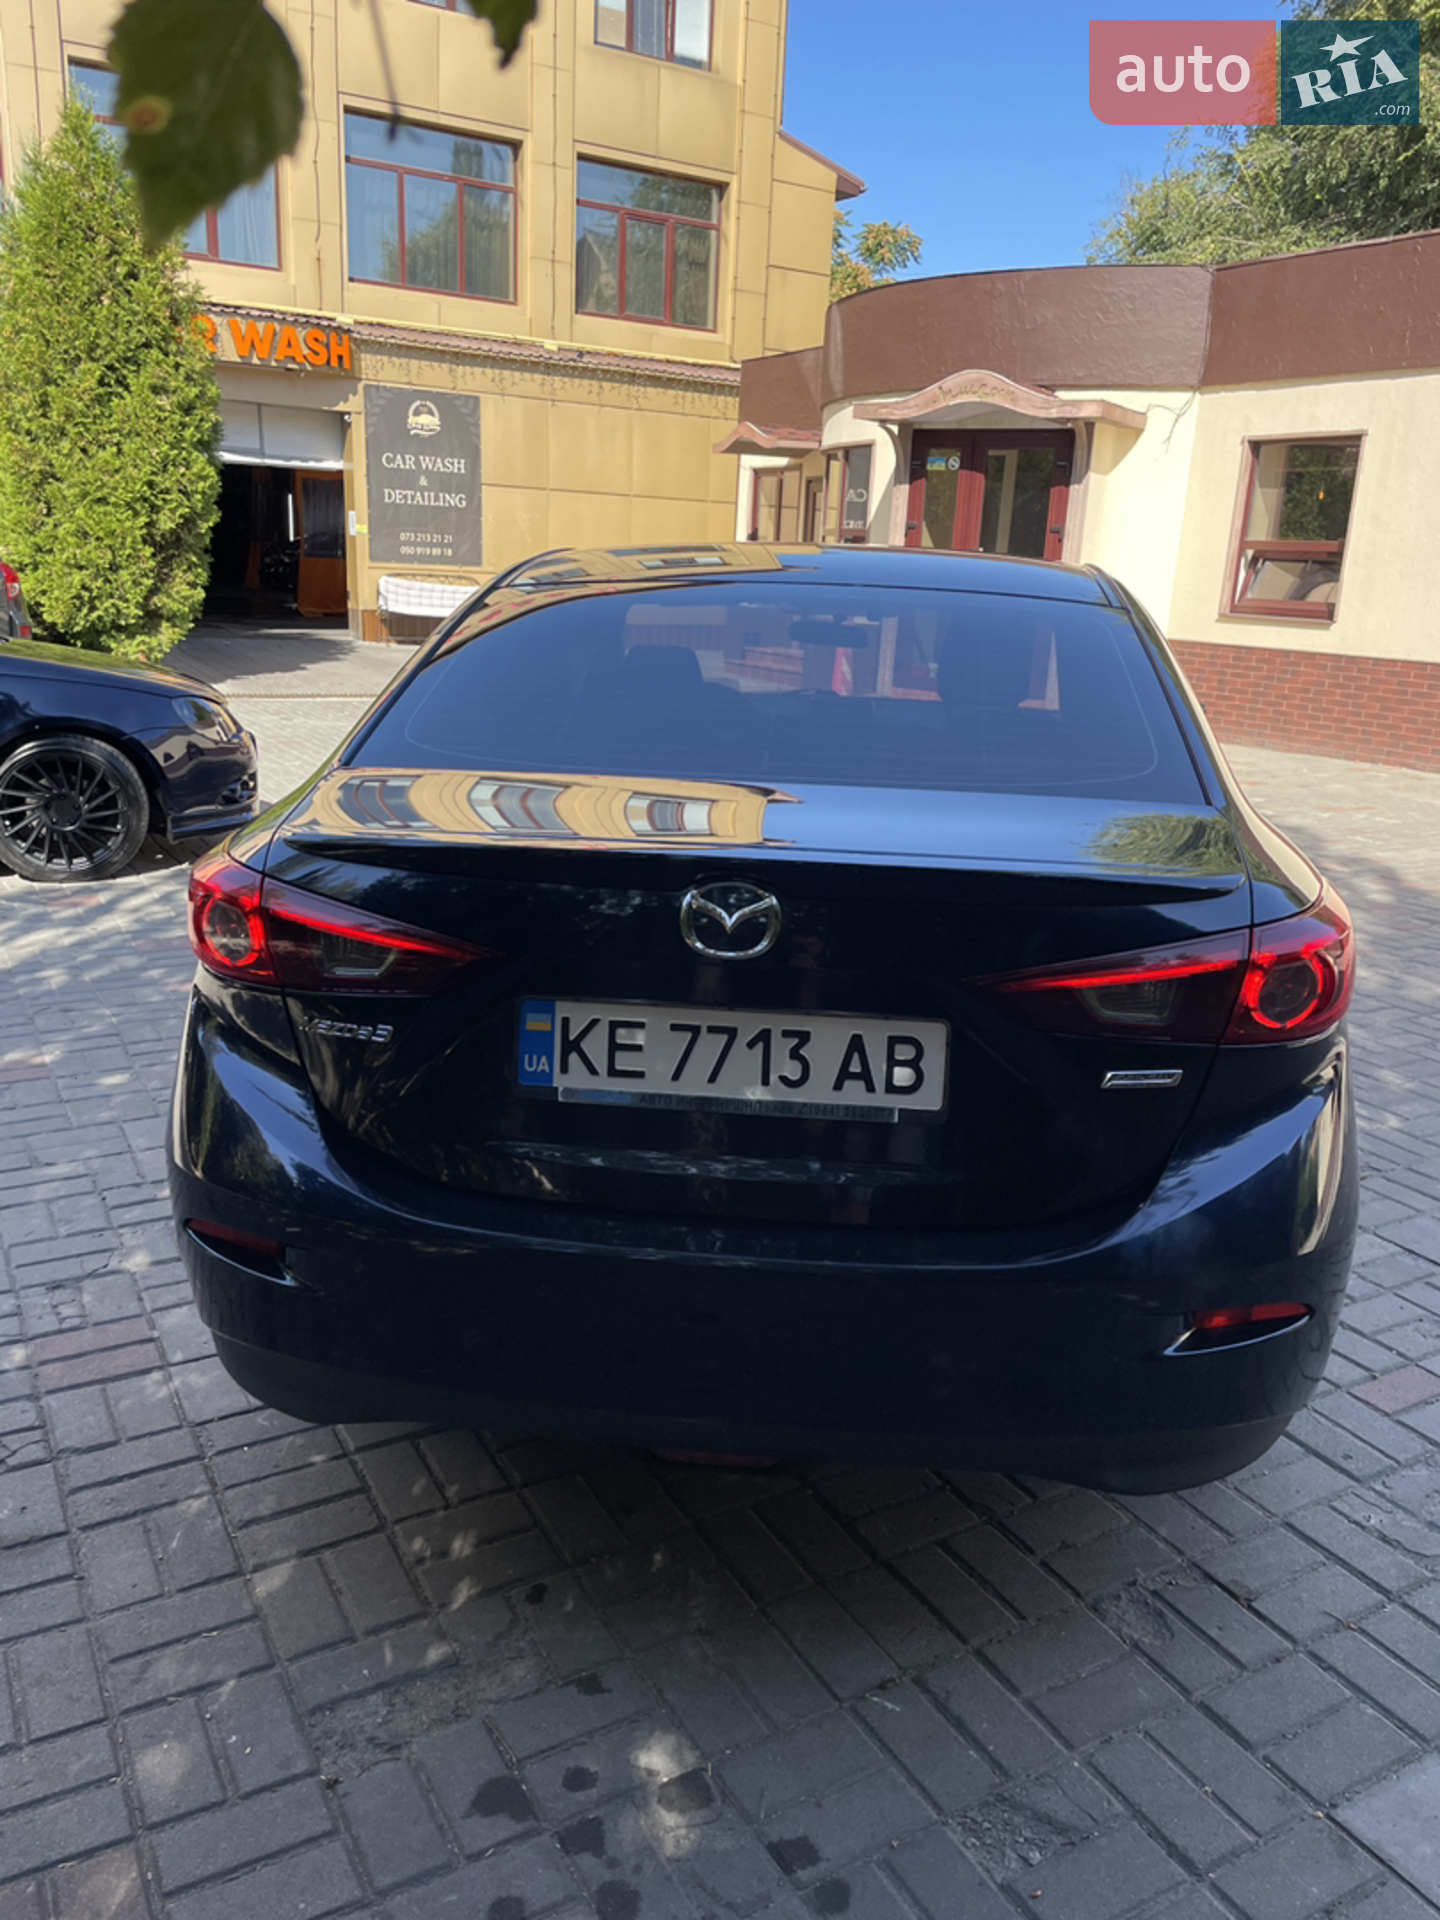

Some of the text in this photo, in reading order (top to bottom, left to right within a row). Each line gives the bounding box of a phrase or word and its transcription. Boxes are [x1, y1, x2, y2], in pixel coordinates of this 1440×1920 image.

[227, 319, 352, 370] WASH
[382, 452, 466, 474] CAR WASH
[419, 475, 428, 486] &
[383, 488, 467, 508] DETAILING
[432, 533, 442, 543] 21
[443, 534, 453, 543] 21
[523, 1016, 926, 1096] UA KE 7713 AB
